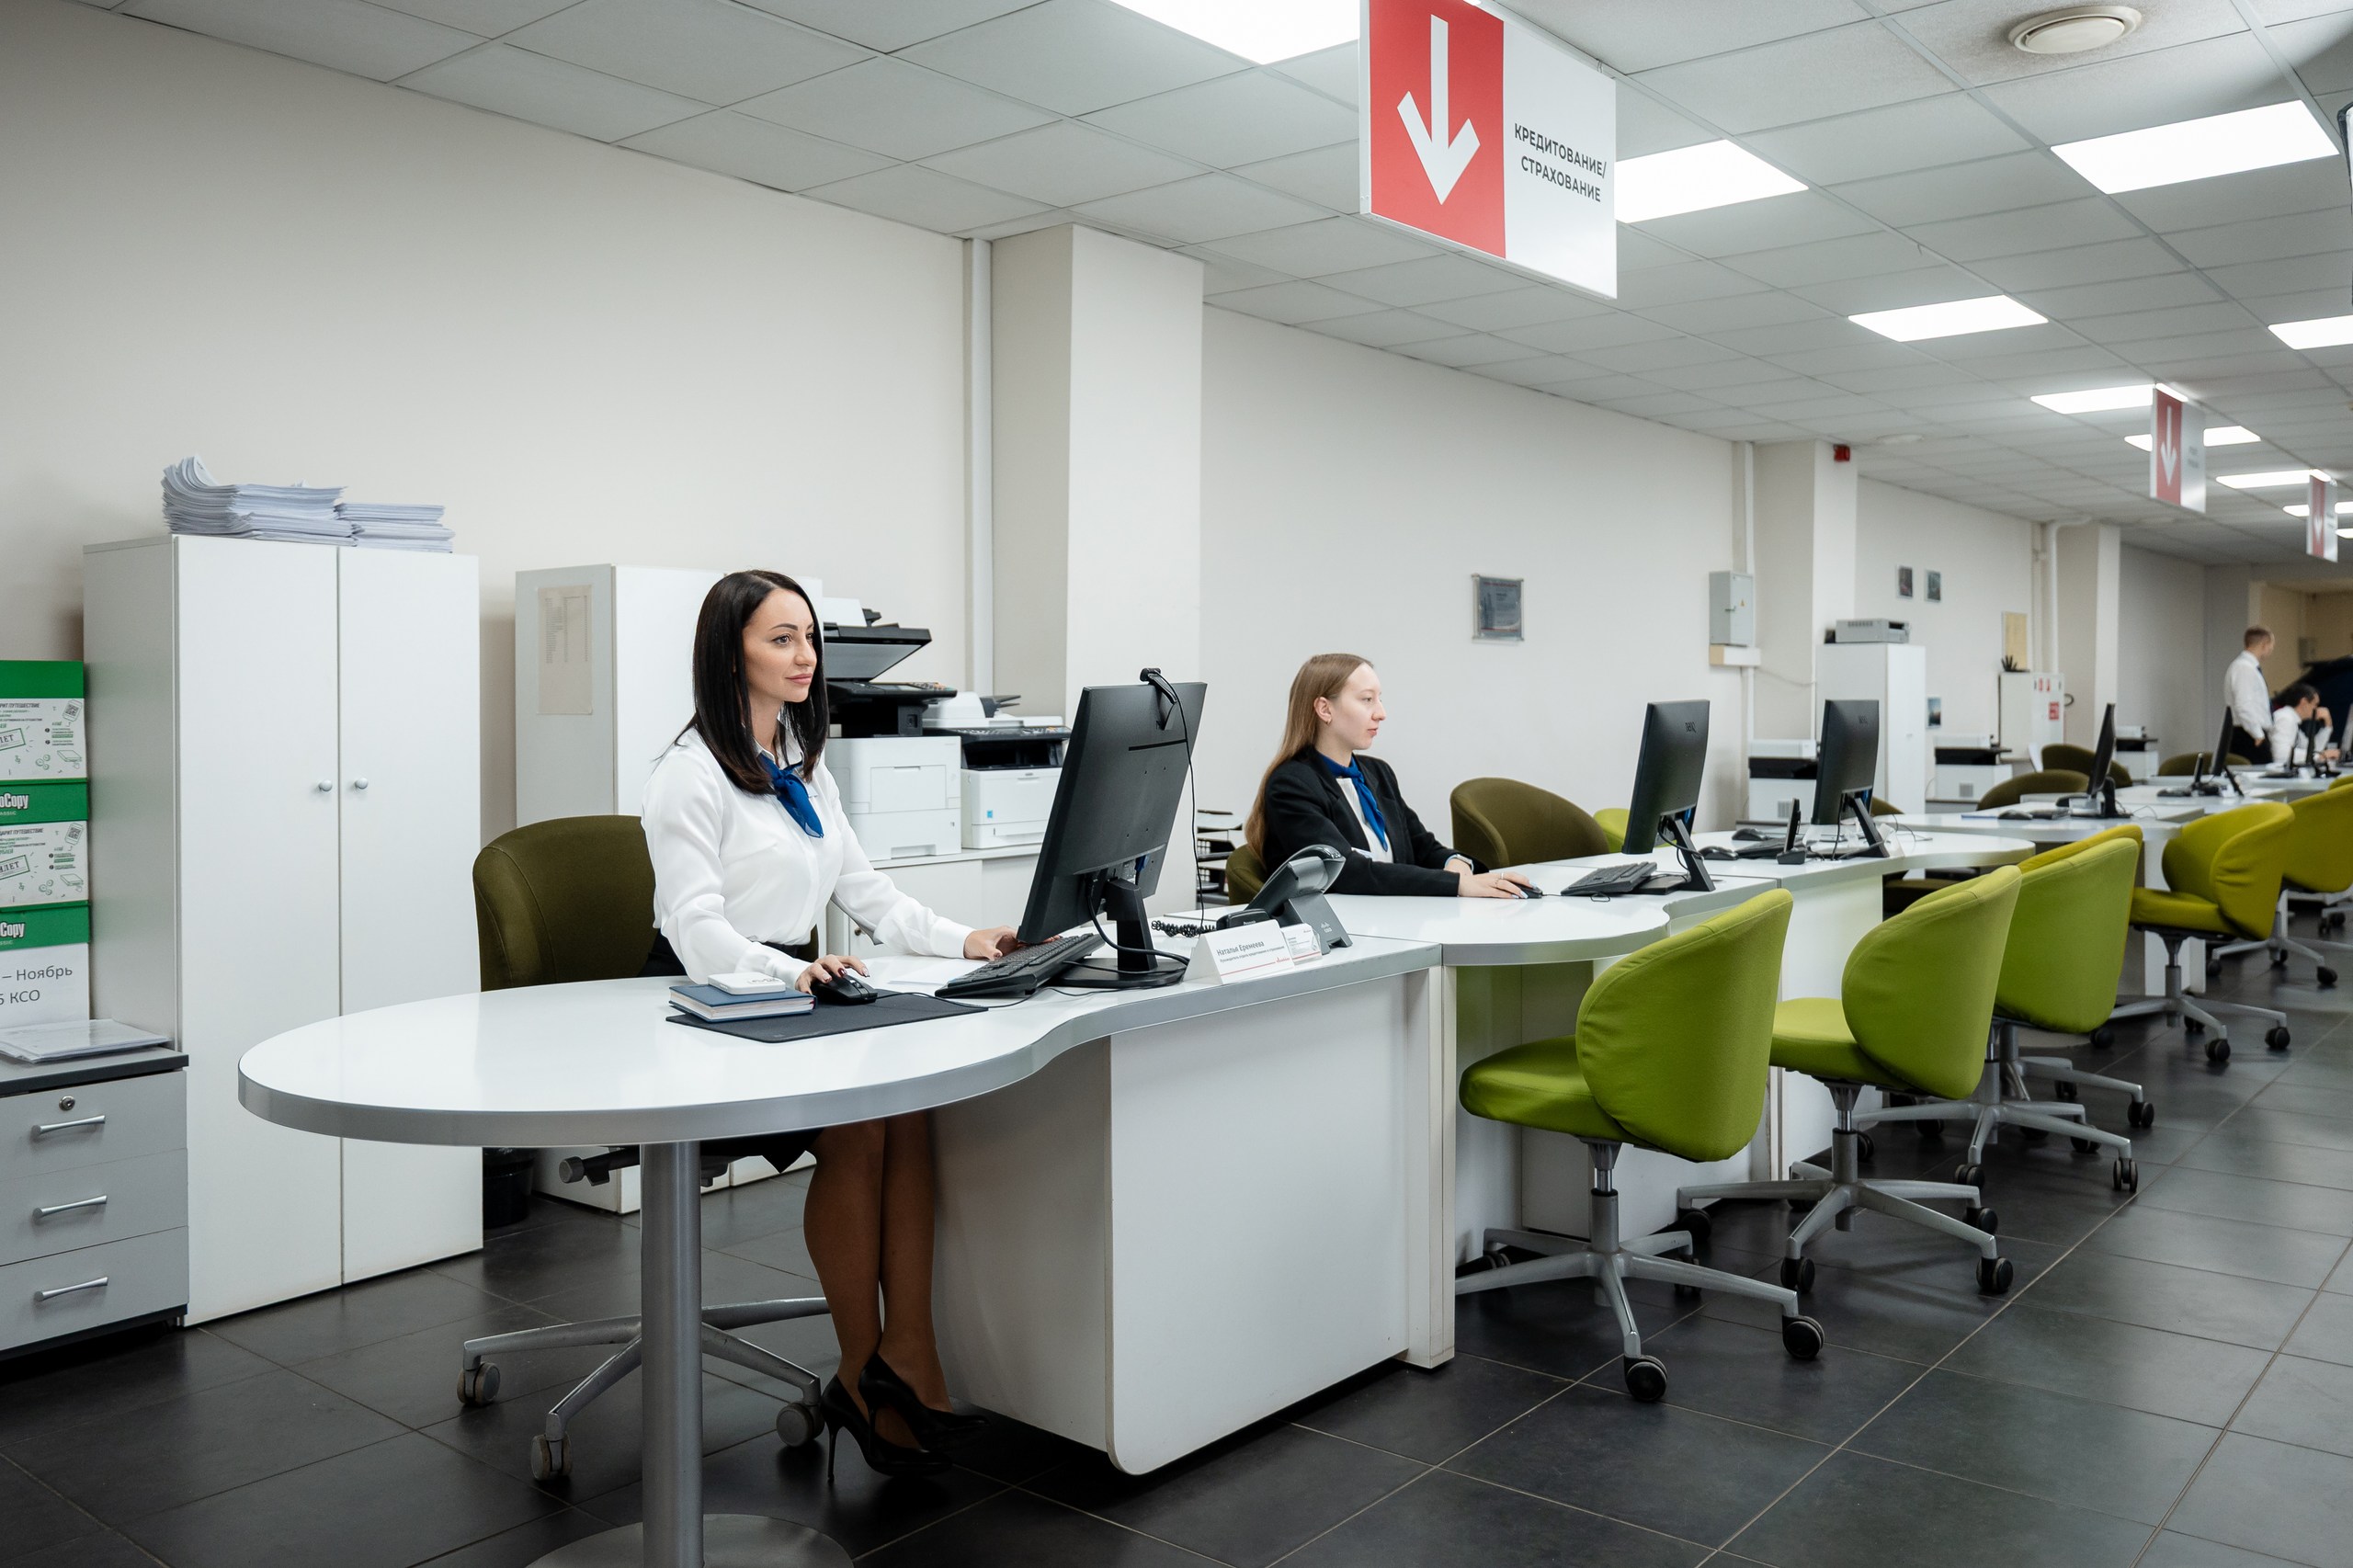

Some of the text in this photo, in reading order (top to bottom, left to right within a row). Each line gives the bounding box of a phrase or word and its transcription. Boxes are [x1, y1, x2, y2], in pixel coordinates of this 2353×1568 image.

[1515, 122, 1607, 179] КРЕДИТОВАНИЕ/
[1521, 155, 1601, 202] СТРАХОВАНИЕ
[0, 922, 25, 938] Copy
[1216, 940, 1265, 956] Наталья Еремеева
[17, 965, 73, 981] Ноябрь
[10, 989, 40, 1004] КСО
